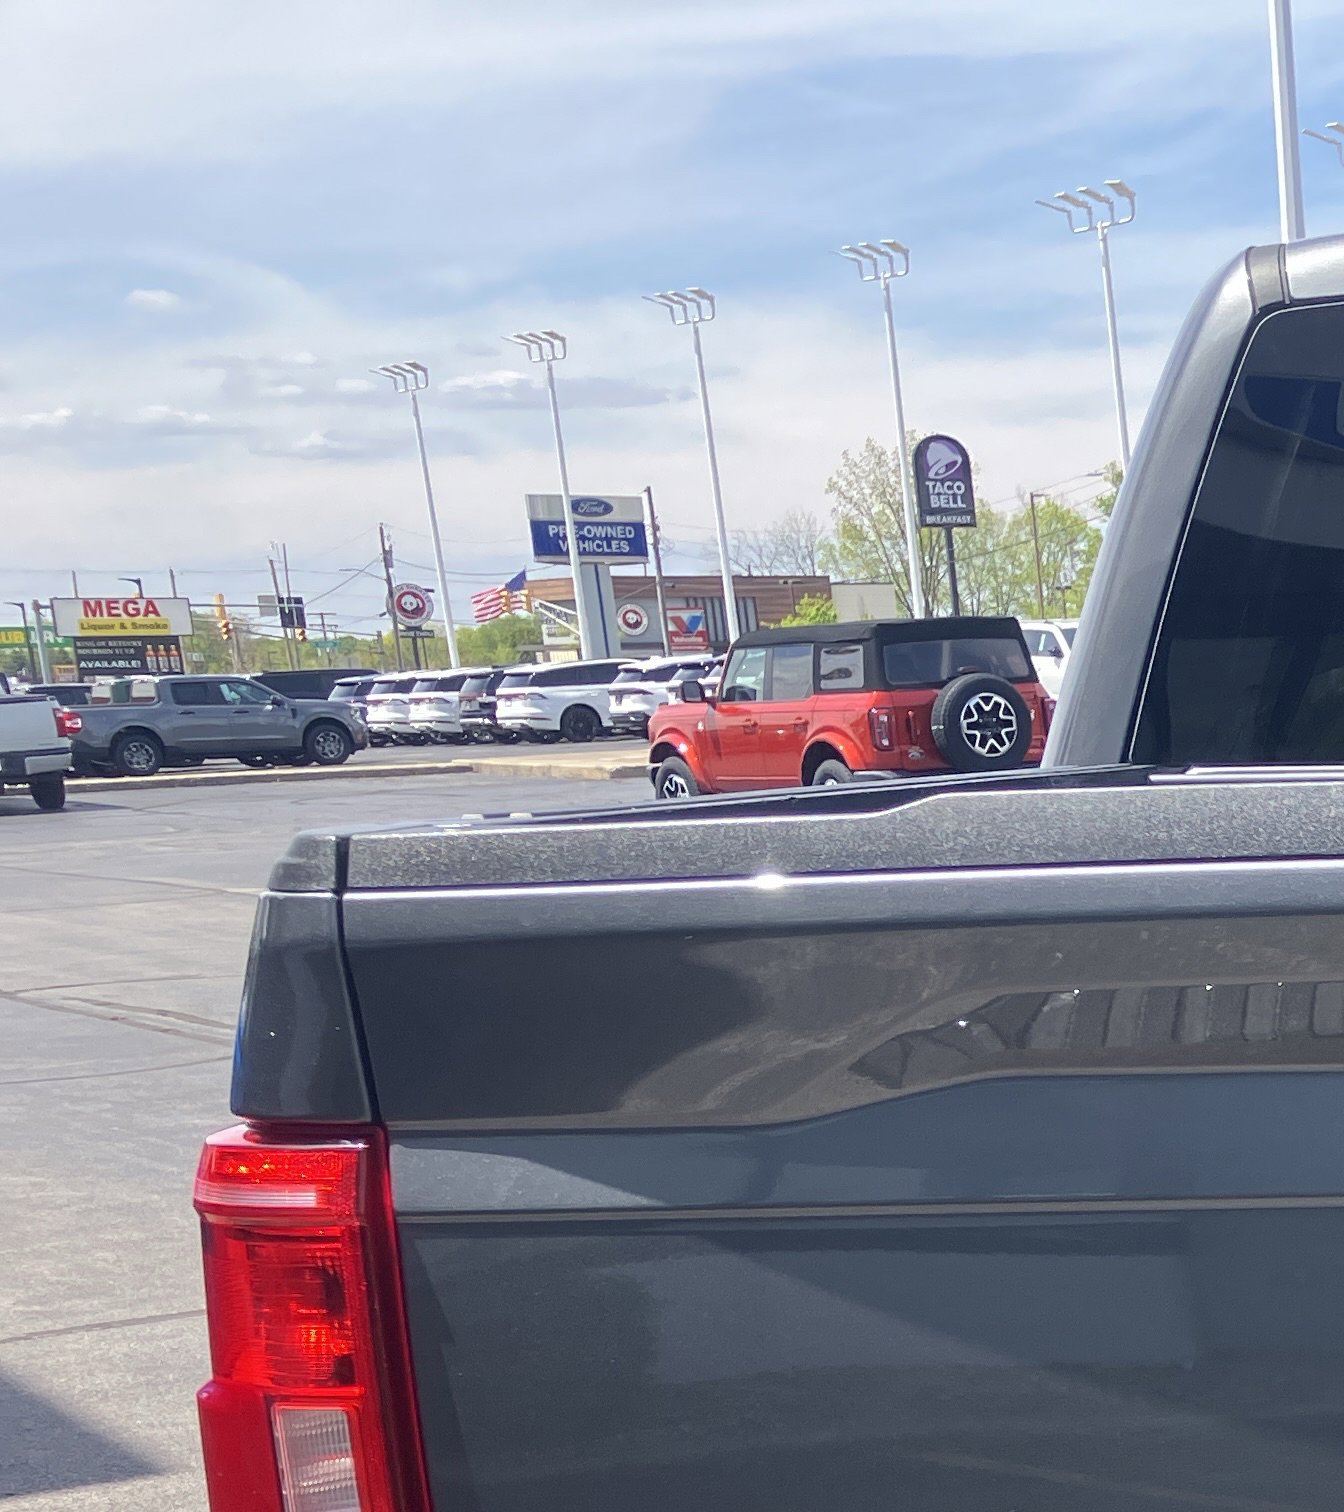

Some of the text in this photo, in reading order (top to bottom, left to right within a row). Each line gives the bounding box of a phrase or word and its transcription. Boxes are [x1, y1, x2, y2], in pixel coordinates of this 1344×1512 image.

[925, 480, 965, 494] TACO
[577, 501, 605, 514] Ford
[929, 494, 967, 508] BELL
[559, 539, 630, 553] VHICLES
[82, 600, 161, 618] MEGA
[80, 622, 169, 631] Liquor & Smoke
